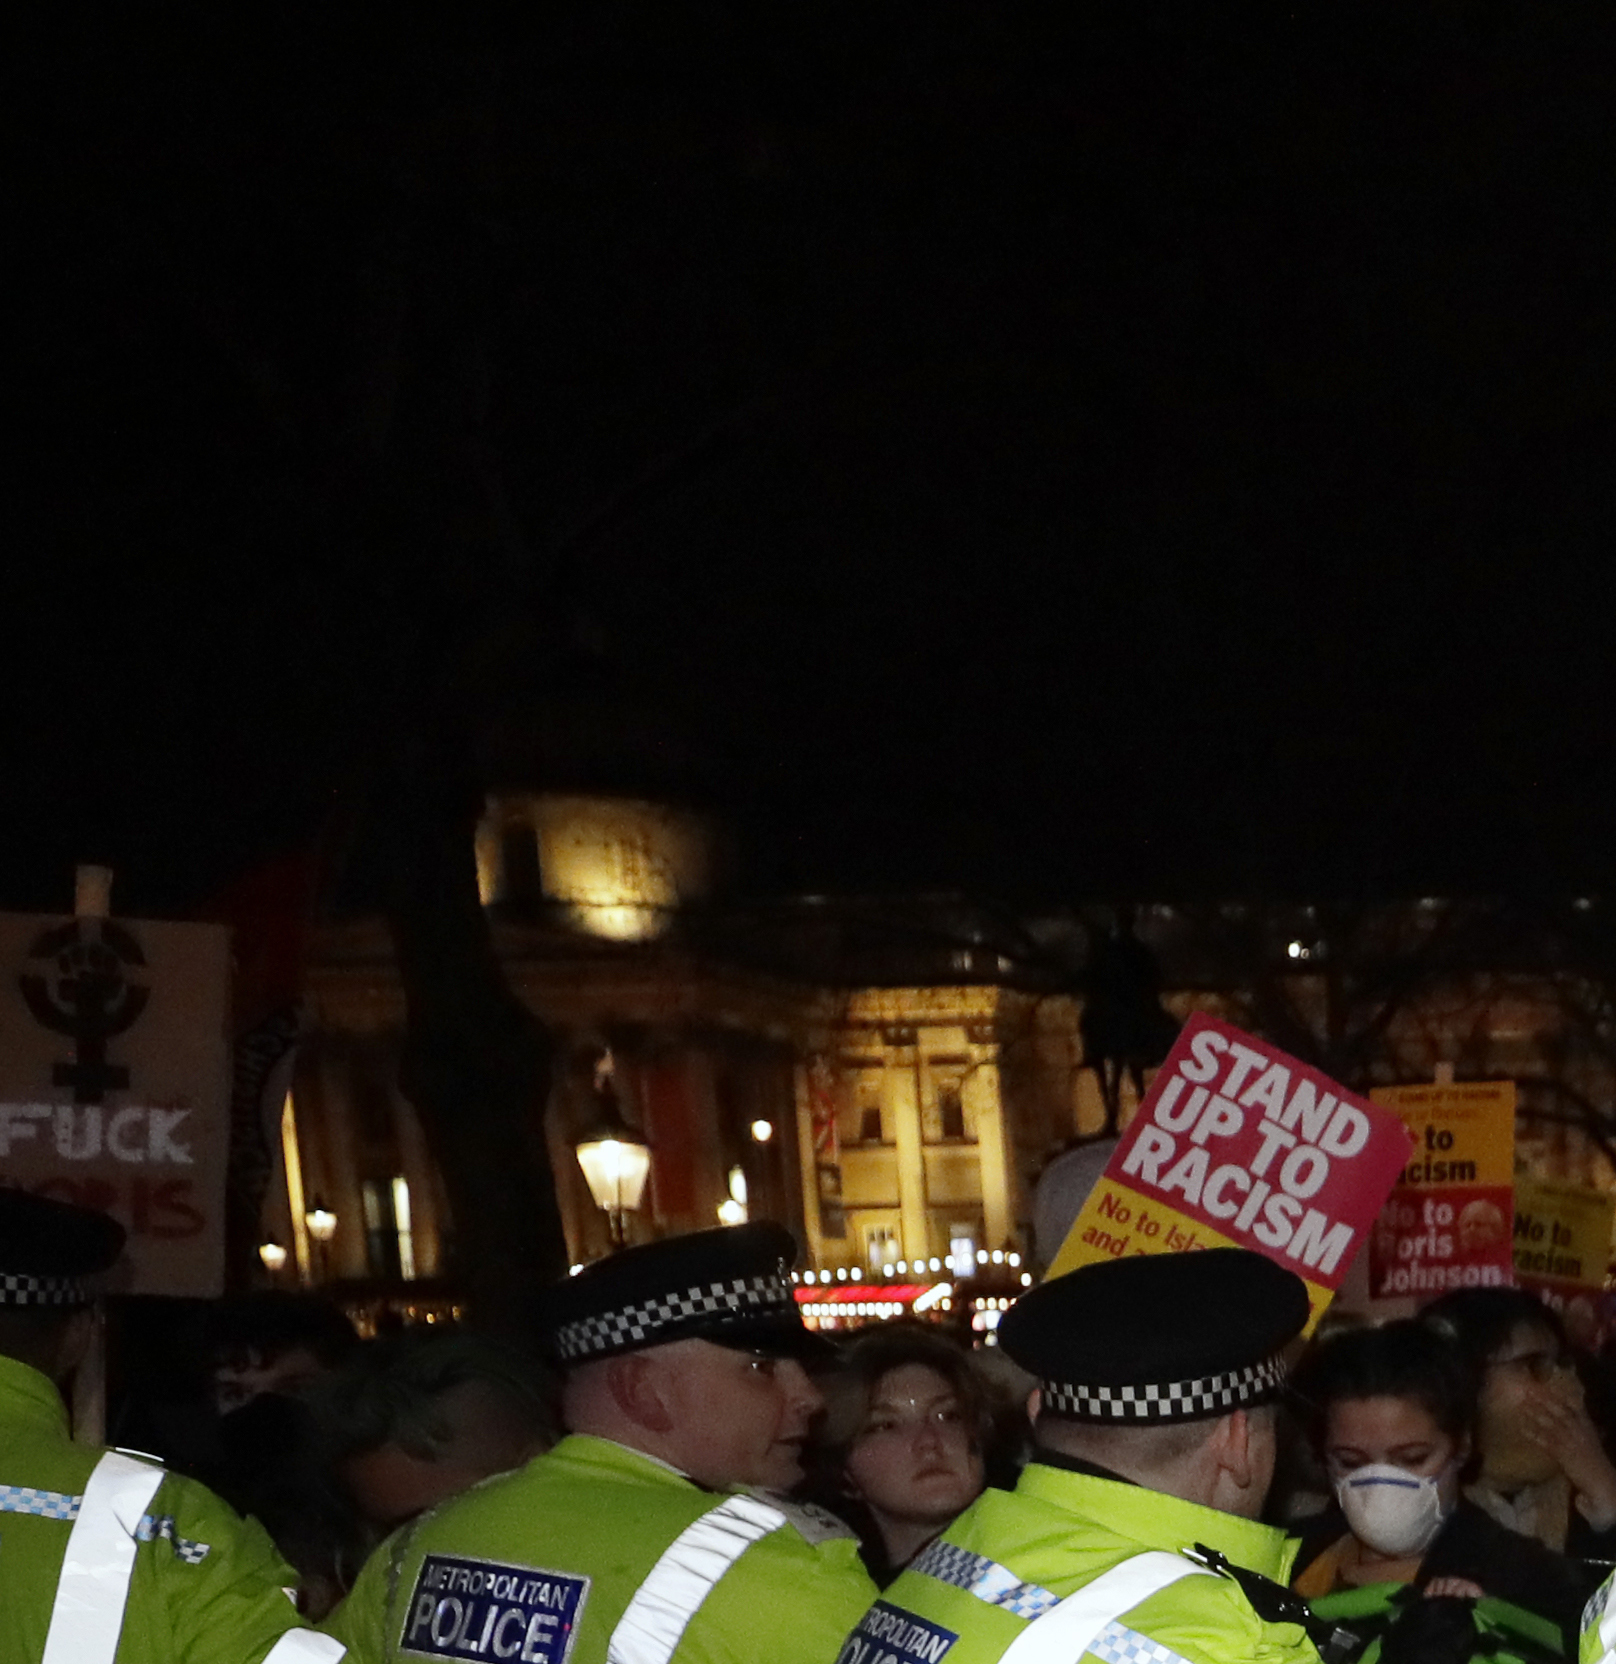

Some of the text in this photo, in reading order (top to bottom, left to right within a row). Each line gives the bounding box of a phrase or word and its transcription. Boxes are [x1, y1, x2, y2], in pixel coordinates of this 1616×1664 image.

[1178, 1029, 1371, 1159] STAND
[0, 1102, 194, 1164] FUCK
[1154, 1074, 1330, 1199] UP TO
[1424, 1123, 1454, 1151] to
[1098, 1192, 1132, 1225] No
[1135, 1211, 1160, 1238] to
[1121, 1124, 1355, 1276] RACISM
[1423, 1197, 1454, 1226] to
[1082, 1226, 1131, 1257] and
[1513, 1210, 1573, 1247] No to
[423, 1563, 570, 1612] METROPOLITAN
